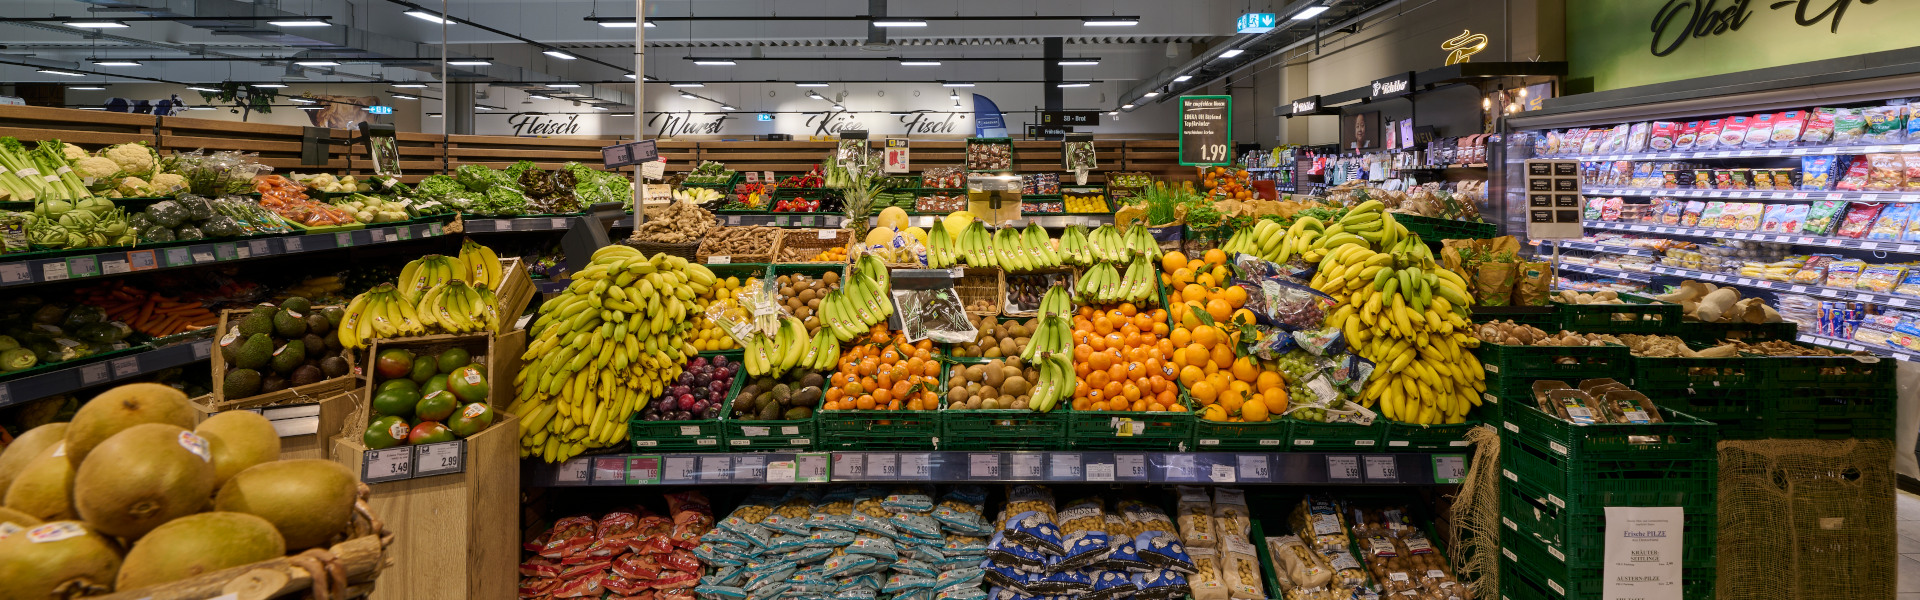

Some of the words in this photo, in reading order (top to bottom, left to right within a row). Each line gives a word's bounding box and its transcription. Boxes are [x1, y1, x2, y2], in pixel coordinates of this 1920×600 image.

[1382, 80, 1408, 94] Tchibo
[508, 111, 581, 137] Fleisch
[648, 110, 733, 138] Wurst
[806, 110, 863, 136] Käse
[900, 110, 956, 138] Fisch
[1415, 132, 1433, 144] NEU
[1201, 144, 1226, 161] 1.99
[442, 456, 457, 467] 2.99
[391, 462, 408, 473] 3.49
[752, 468, 762, 477] 1.29
[987, 466, 998, 474] 1.99
[1029, 466, 1040, 474] 1.99
[1346, 468, 1357, 476] 5.99
[1383, 468, 1394, 476] 5.99
